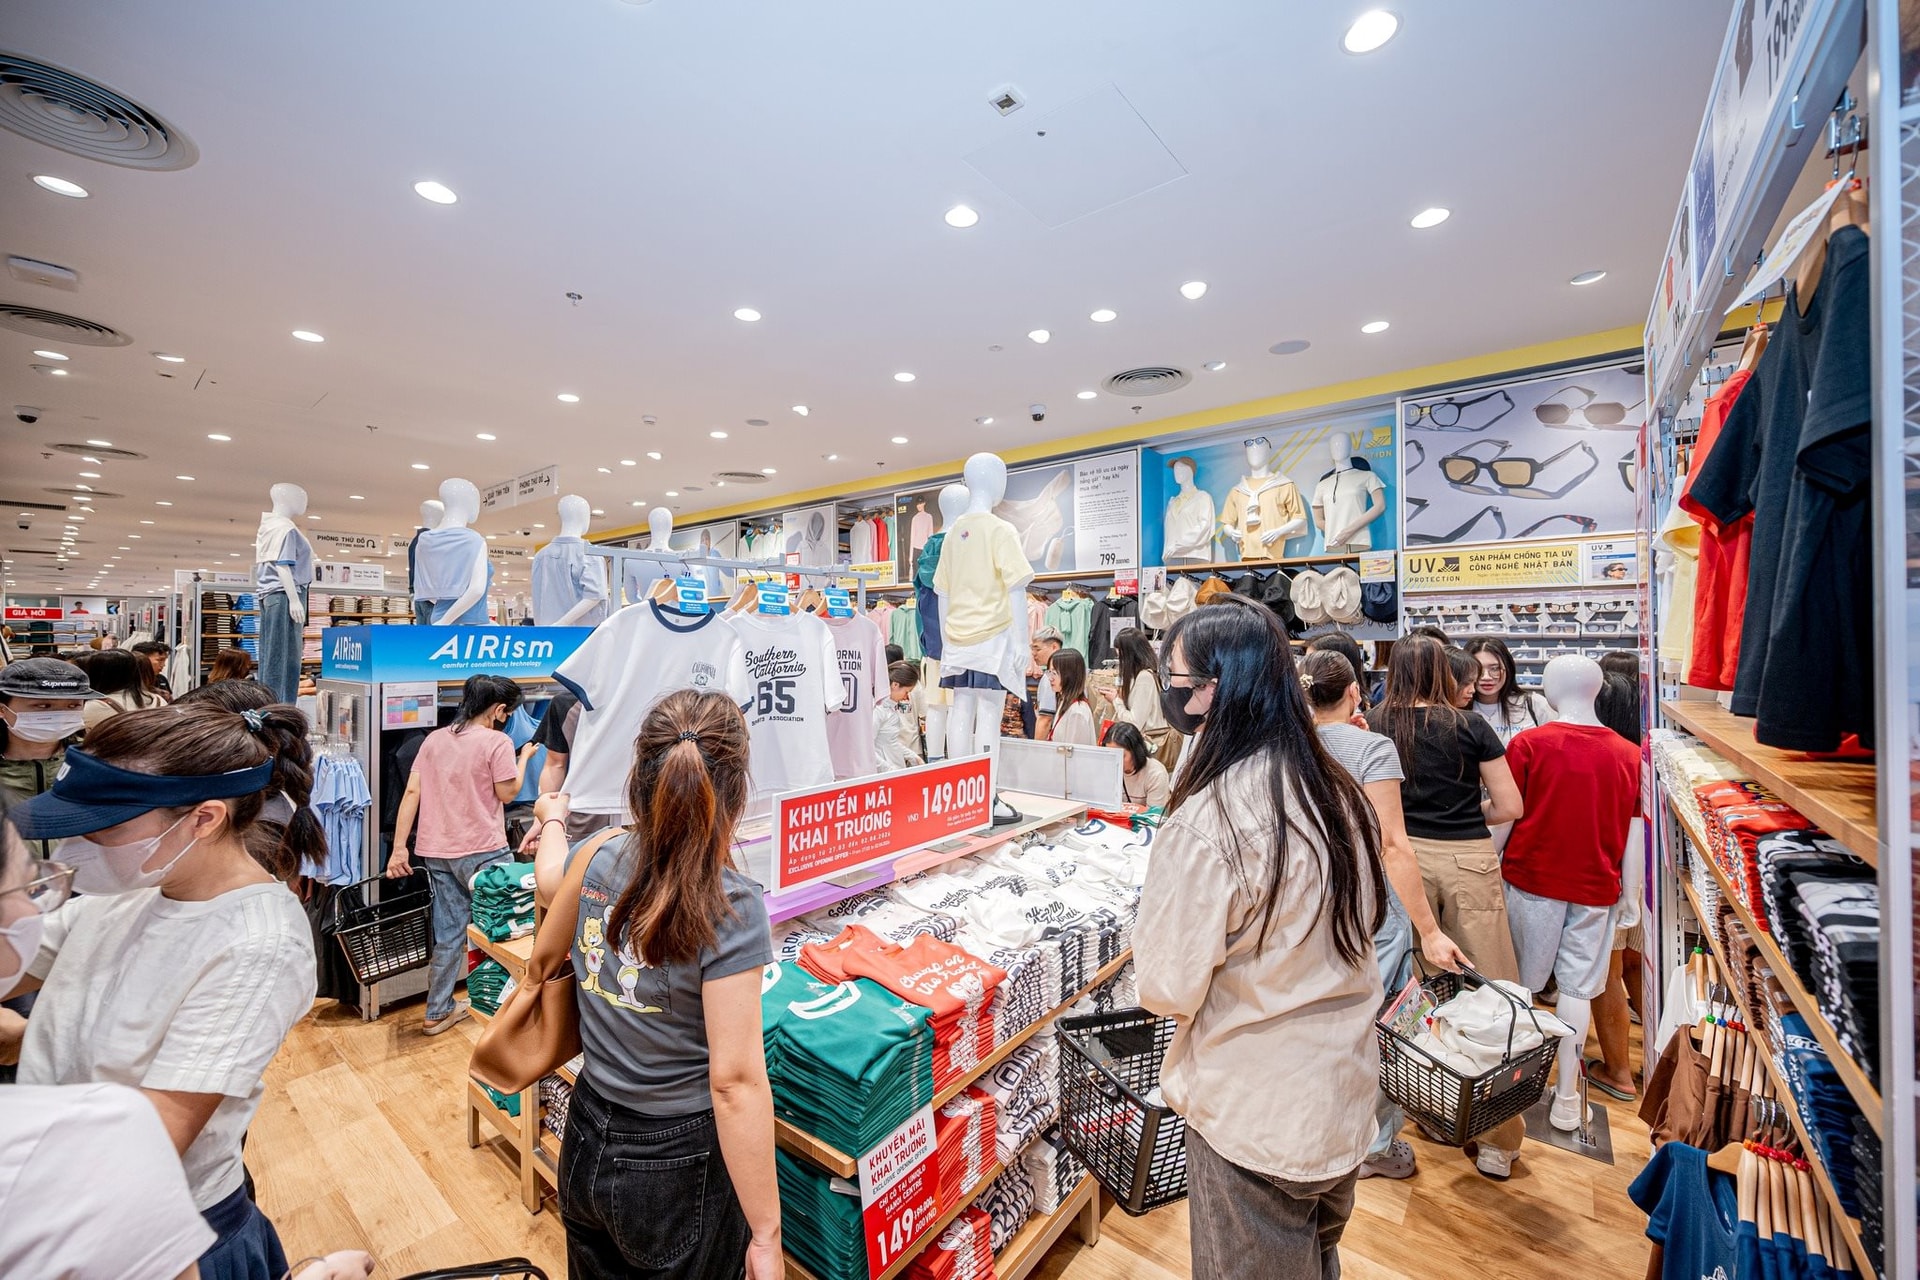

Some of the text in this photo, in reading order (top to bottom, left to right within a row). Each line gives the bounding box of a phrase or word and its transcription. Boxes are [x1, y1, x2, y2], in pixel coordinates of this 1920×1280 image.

[1100, 553, 1116, 566] 799
[1409, 558, 1436, 574] UV
[1409, 575, 1460, 583] PROTECTION
[332, 636, 362, 661] AIRism
[428, 634, 554, 660] AIRism
[745, 645, 797, 667] Southern
[470, 660, 508, 668] conditioning
[748, 660, 806, 681] California
[41, 680, 78, 688] Supreme
[757, 680, 796, 716] 65
[789, 785, 892, 829] KHUYẾN MÃI
[922, 774, 986, 819] 149.000
[907, 813, 919, 823] VND
[788, 810, 892, 854] KHAI TRƯƠNG
[869, 1118, 925, 1170] KHUYẾN MÃI
[871, 1133, 927, 1186] KHAI TRƯƠNG
[872, 1145, 928, 1195] EXCLUSIVE OPENING OFFER
[879, 1193, 889, 1209] CHỈ
[889, 1187, 897, 1200] CÓ
[898, 1180, 907, 1192] TẠI
[907, 1164, 926, 1184] UNIQLO
[885, 1196, 902, 1215] HANOI
[877, 1208, 914, 1266] 149
